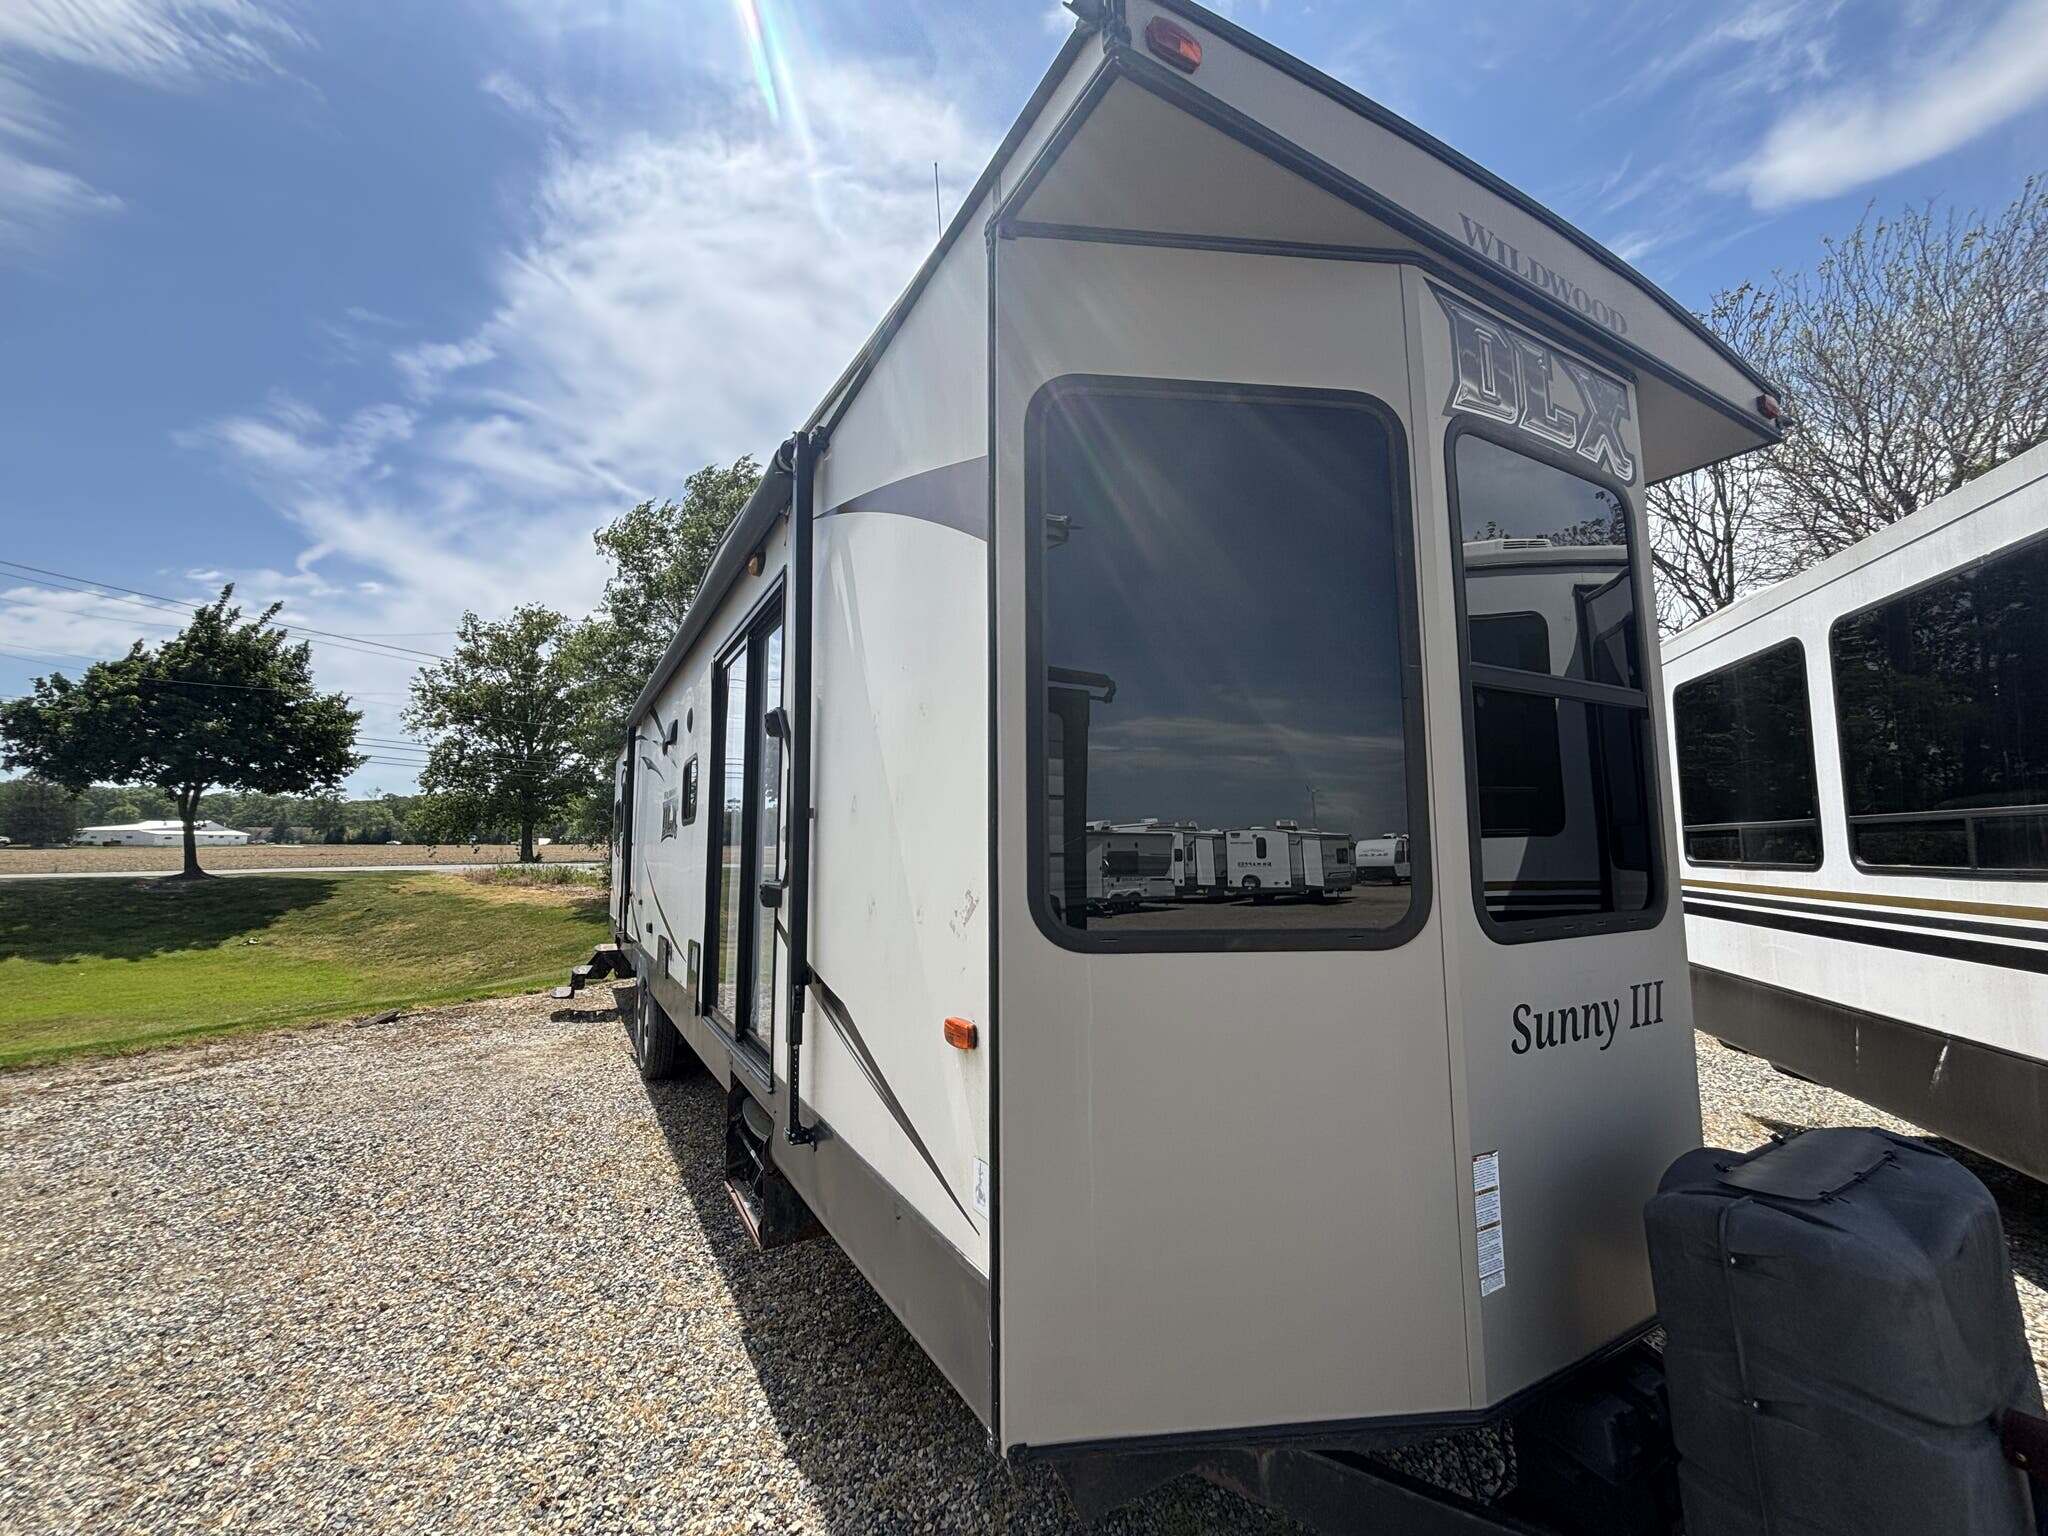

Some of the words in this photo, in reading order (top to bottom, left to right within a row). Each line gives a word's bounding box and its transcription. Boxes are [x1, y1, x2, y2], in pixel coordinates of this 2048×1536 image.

[1458, 212, 1629, 335] WILDWOOD
[1424, 277, 1637, 487] DLX
[1511, 998, 1620, 1055] Sunny
[1629, 980, 1664, 1030] III
